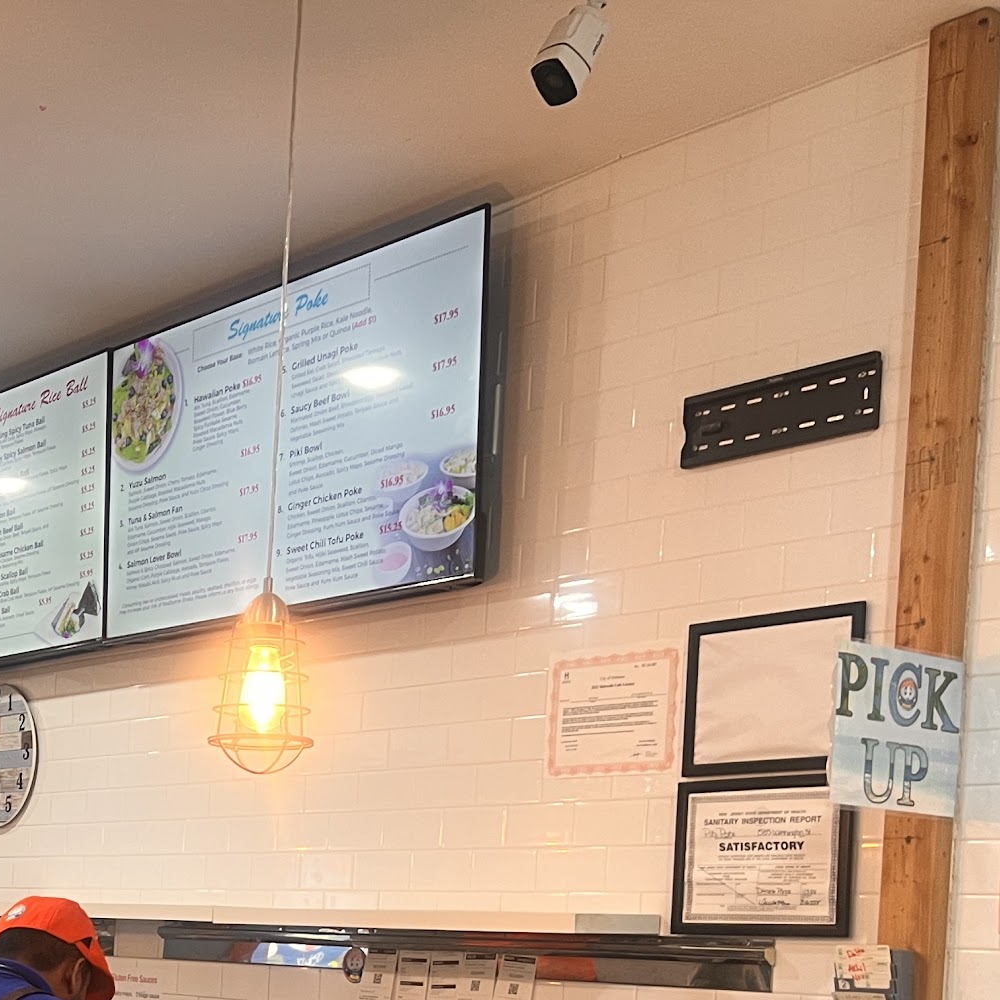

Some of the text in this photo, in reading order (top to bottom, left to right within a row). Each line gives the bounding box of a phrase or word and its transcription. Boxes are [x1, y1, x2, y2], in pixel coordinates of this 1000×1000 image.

[295, 288, 328, 317] Poke
[434, 307, 459, 325] $17.95
[292, 343, 358, 371] Grilled Unagi Poke
[433, 355, 457, 372] $17.95
[40, 389, 61, 408] Rice
[66, 376, 88, 397] Ball
[194, 374, 262, 403] Hawaiian Poke $16.95
[291, 389, 350, 415] Saucy Beef Bowl
[431, 404, 456, 420] $16.95
[82, 422, 96, 433] $5.25
[81, 446, 95, 458] $5.25
[241, 444, 260, 457] $16.95
[290, 442, 323, 458] Piki Bowl
[81, 465, 95, 477] $5.25
[129, 473, 166, 489] Yuzu Salmon
[381, 475, 403, 489] $16.95
[239, 484, 259, 496] $17.95
[288, 487, 362, 511] Ginger Chicken Poke
[128, 516, 142, 525] Tuna
[148, 508, 171, 520] Salmon
[171, 505, 183, 515] Fan
[379, 521, 402, 535] $15.25
[238, 532, 258, 544] $17.95
[287, 532, 364, 555] Sweet Chili Tofu Poke
[127, 549, 182, 569] Salmon Lover Bowl
[1, 570, 18, 581] Scallop
[19, 567, 28, 575] Ball
[836, 652, 959, 733] PICK
[8, 694, 12, 711] 1
[19, 714, 25, 731] 2
[23, 743, 29, 760] 3
[17, 772, 23, 789] 4
[861, 738, 929, 806] UP
[5, 796, 11, 812] 5
[704, 818, 738, 826] SANITARY
[790, 815, 822, 823] REPORT
[719, 841, 804, 851] SATISFACTORY
[128, 974, 138, 982] Free
[139, 975, 157, 983] Sauces
